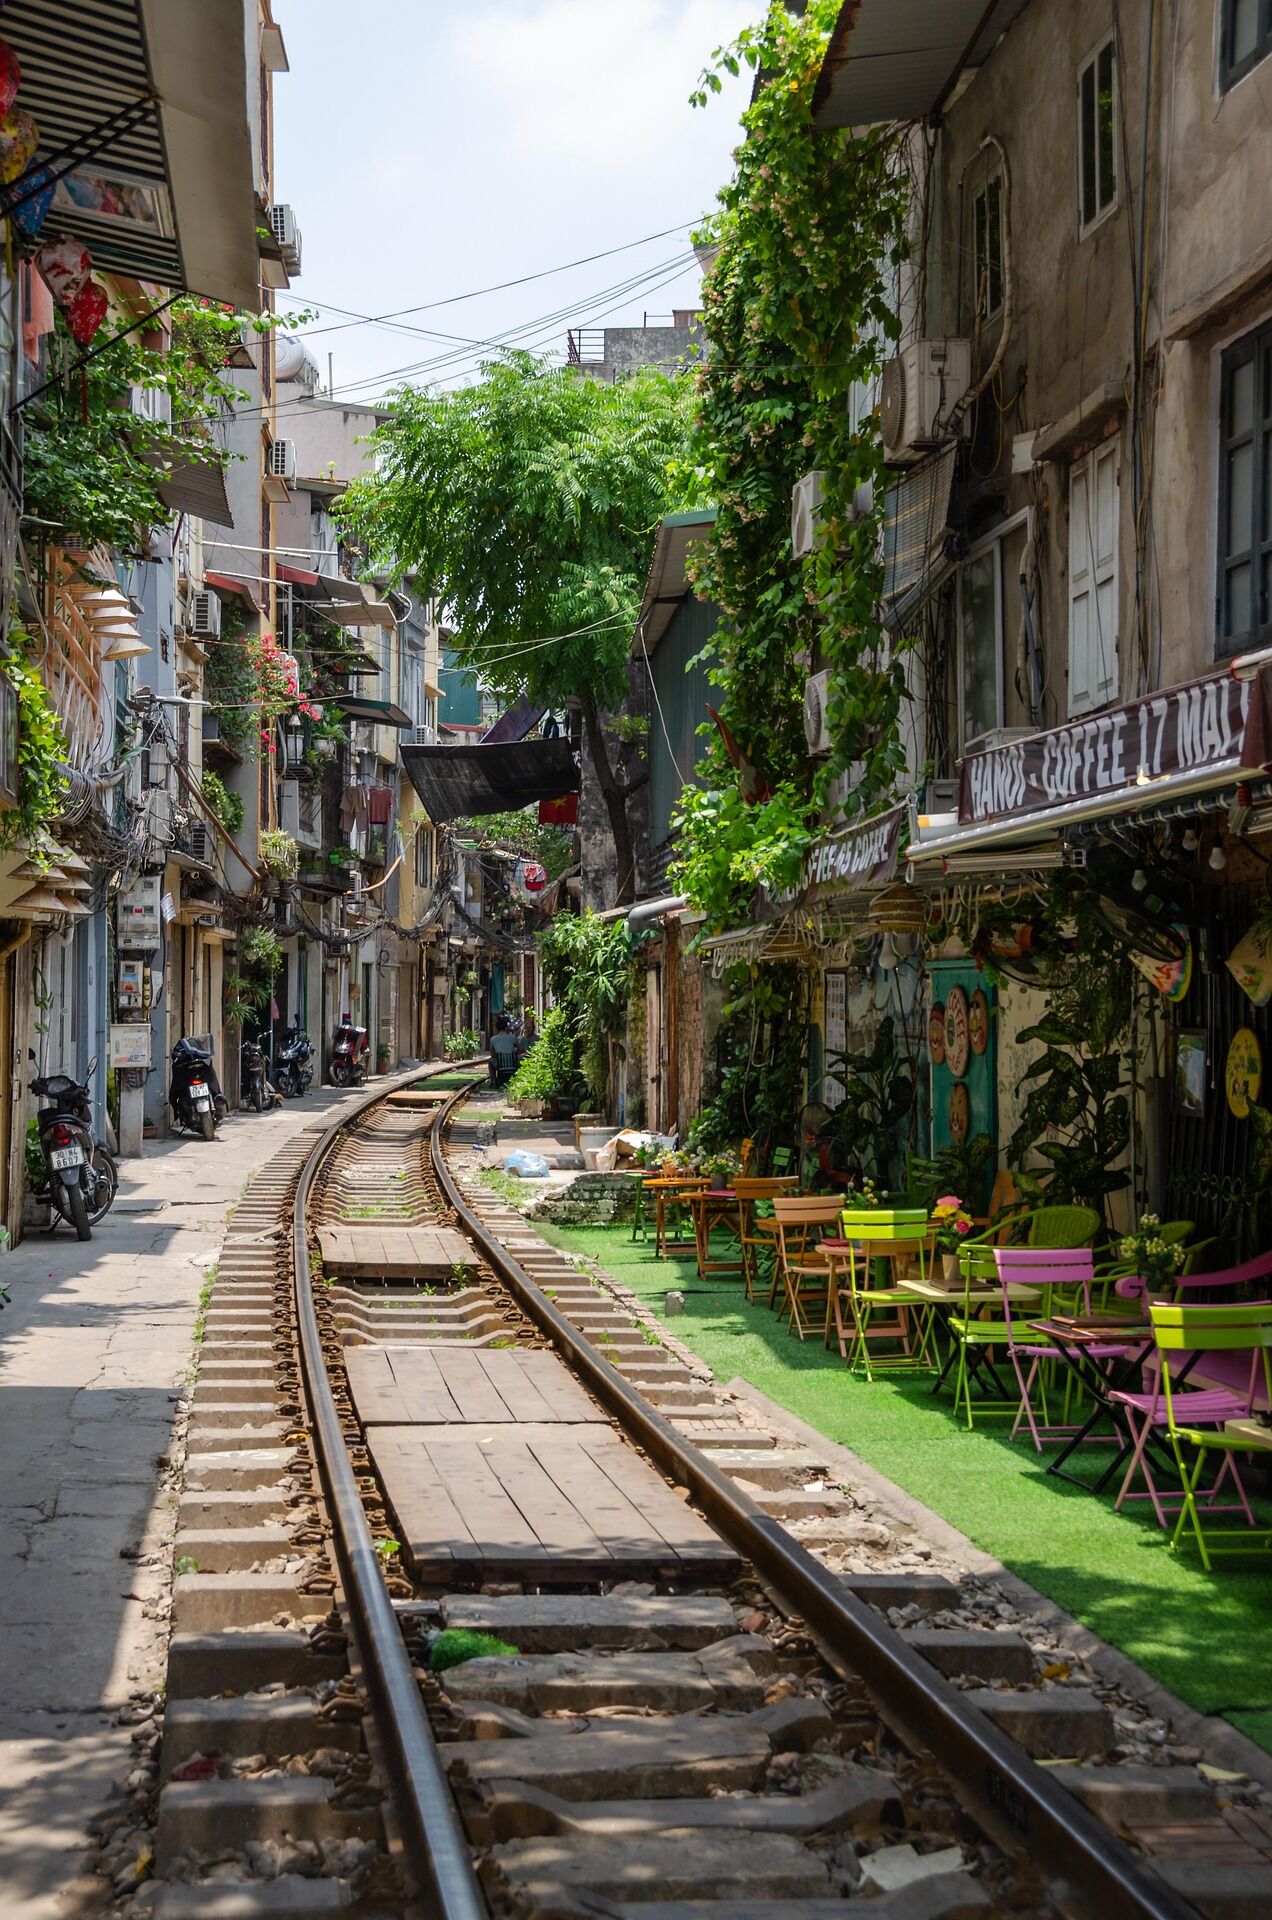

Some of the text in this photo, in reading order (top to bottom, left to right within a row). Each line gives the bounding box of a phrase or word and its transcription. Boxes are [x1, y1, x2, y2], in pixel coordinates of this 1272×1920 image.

[971, 744, 1026, 819] HANOI
[1042, 711, 1127, 800] COFFEE
[1136, 698, 1168, 777] 17
[56, 1156, 79, 1168] 8607
